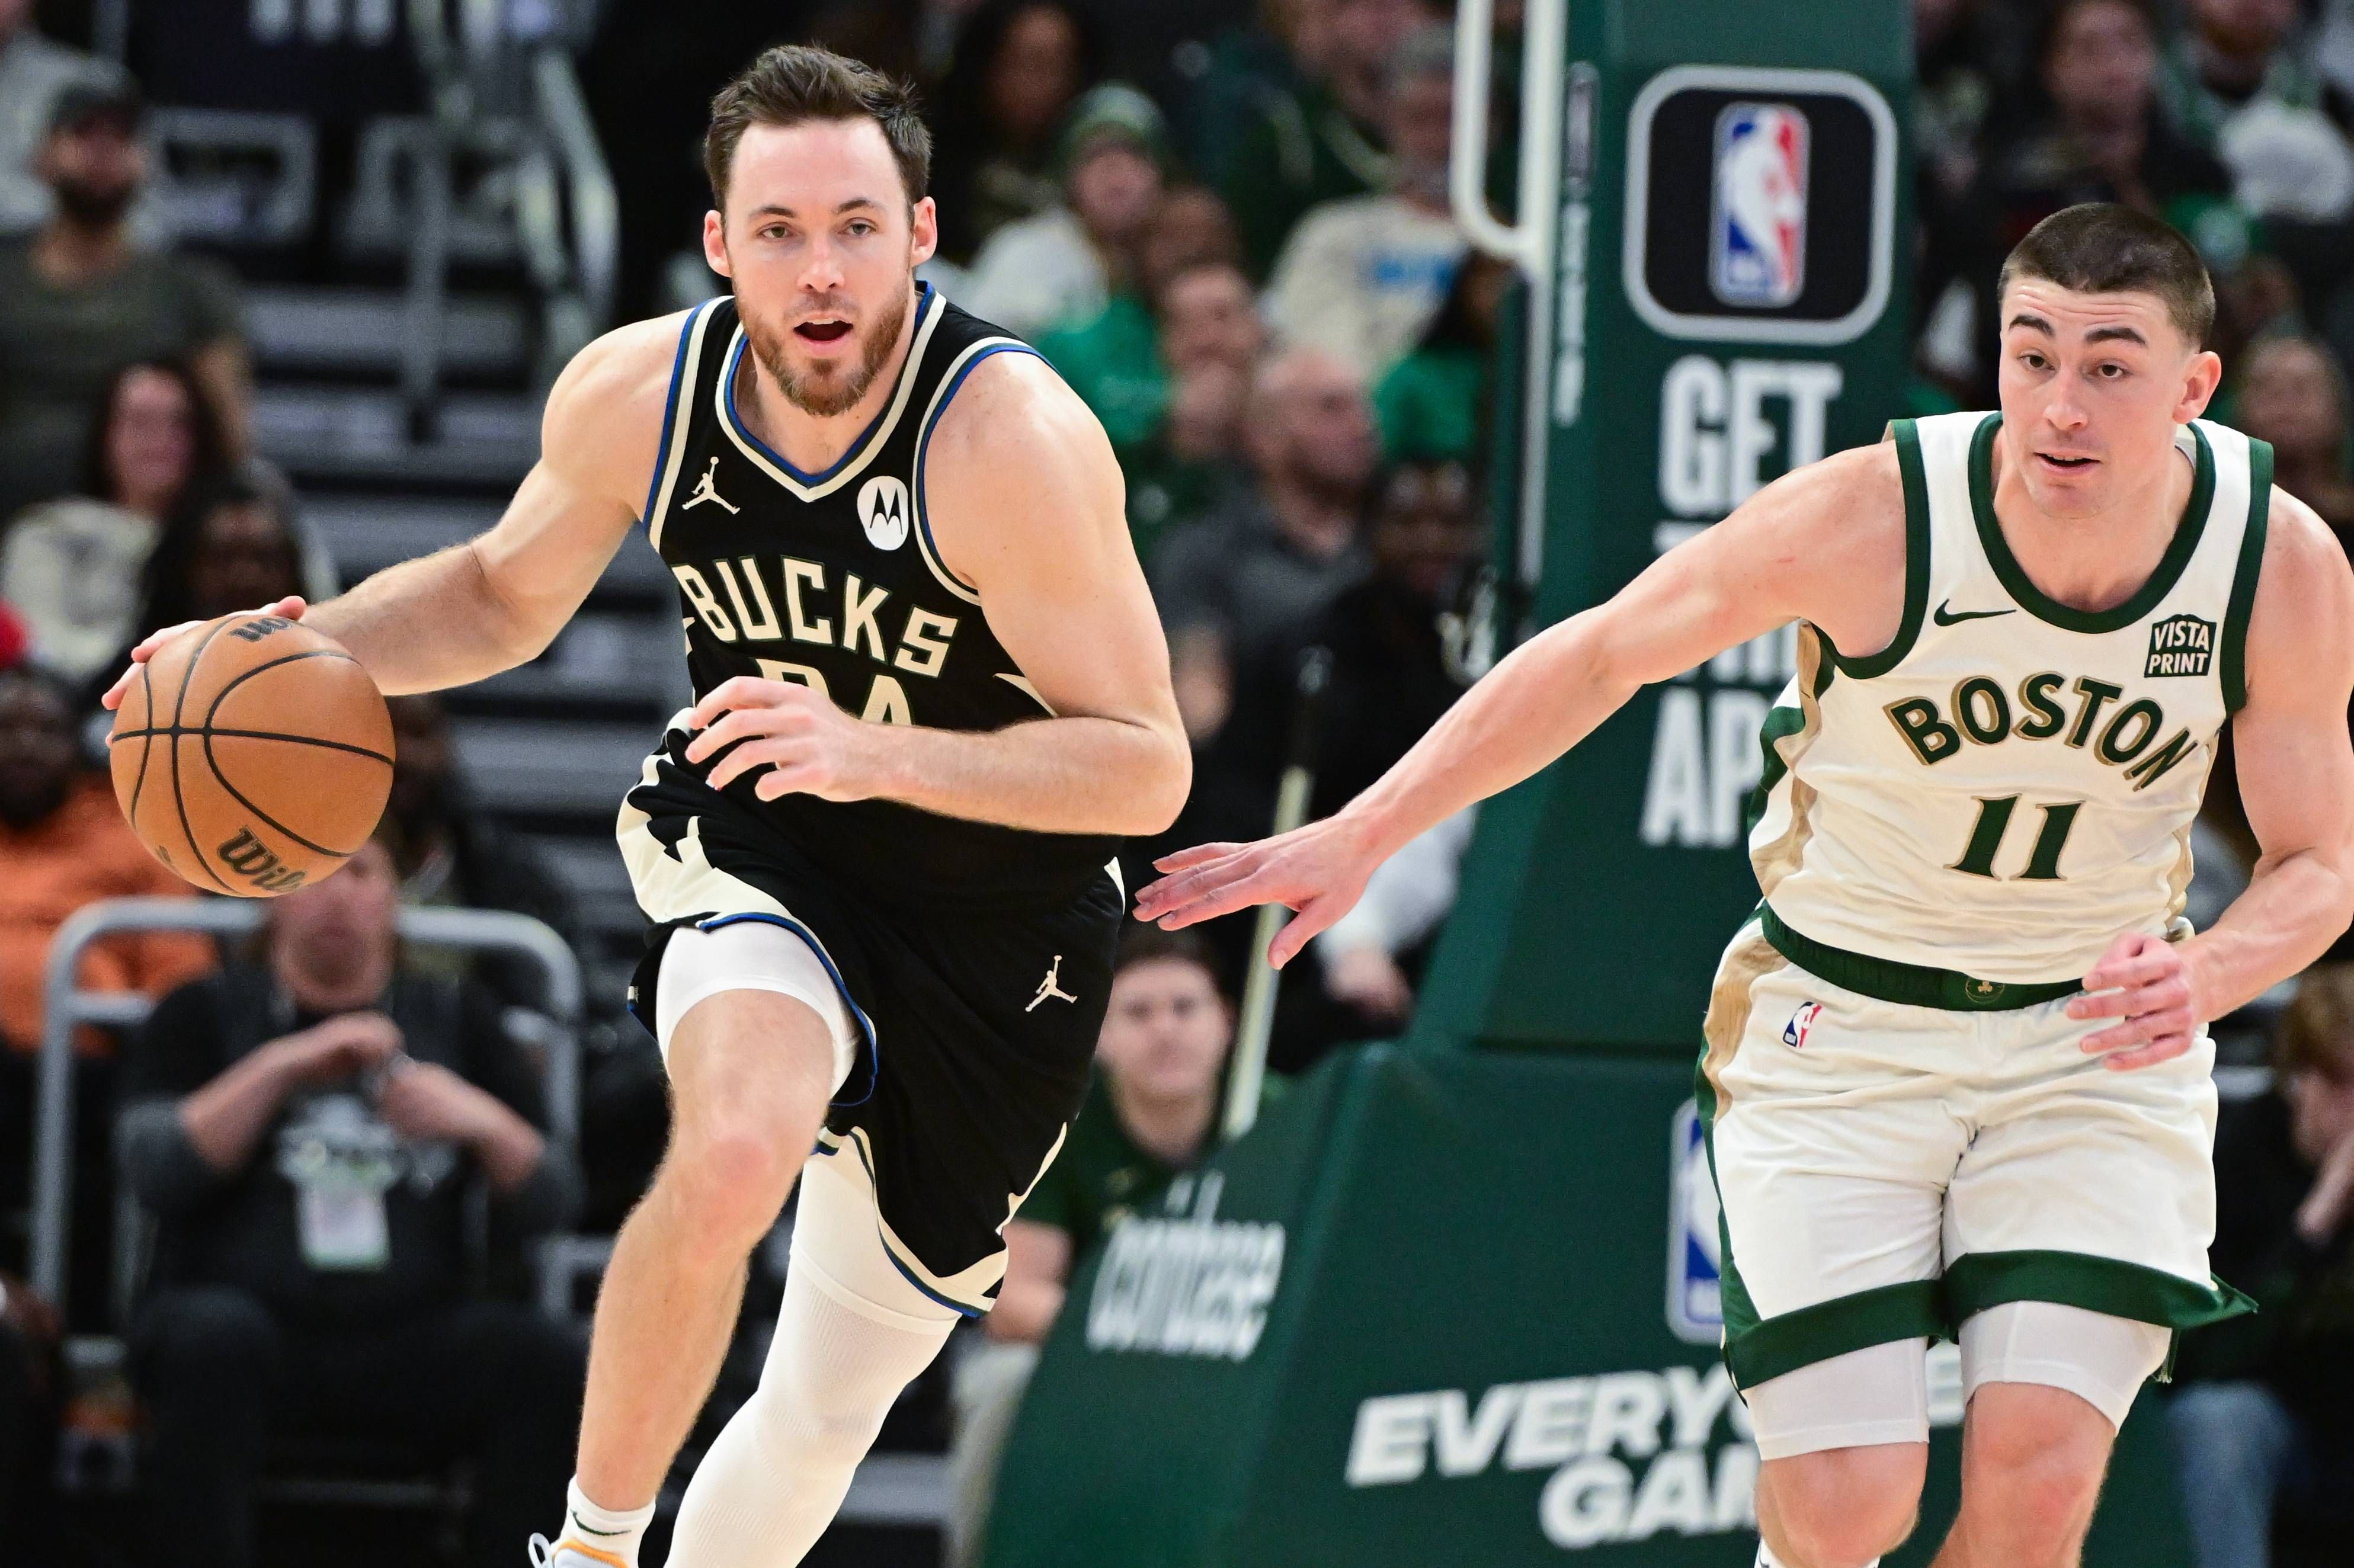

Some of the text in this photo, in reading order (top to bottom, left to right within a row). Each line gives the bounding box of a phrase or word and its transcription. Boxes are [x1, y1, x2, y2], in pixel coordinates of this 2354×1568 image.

[1658, 355, 1843, 514] GET
[671, 554, 961, 679] BUCKS
[2147, 653, 2209, 674] PRINT
[2154, 620, 2210, 652] VISTA
[1640, 685, 1768, 846] AP
[1882, 671, 2199, 793] BOSTON
[1943, 793, 2087, 881] 11
[1344, 1361, 1759, 1488] EVERY
